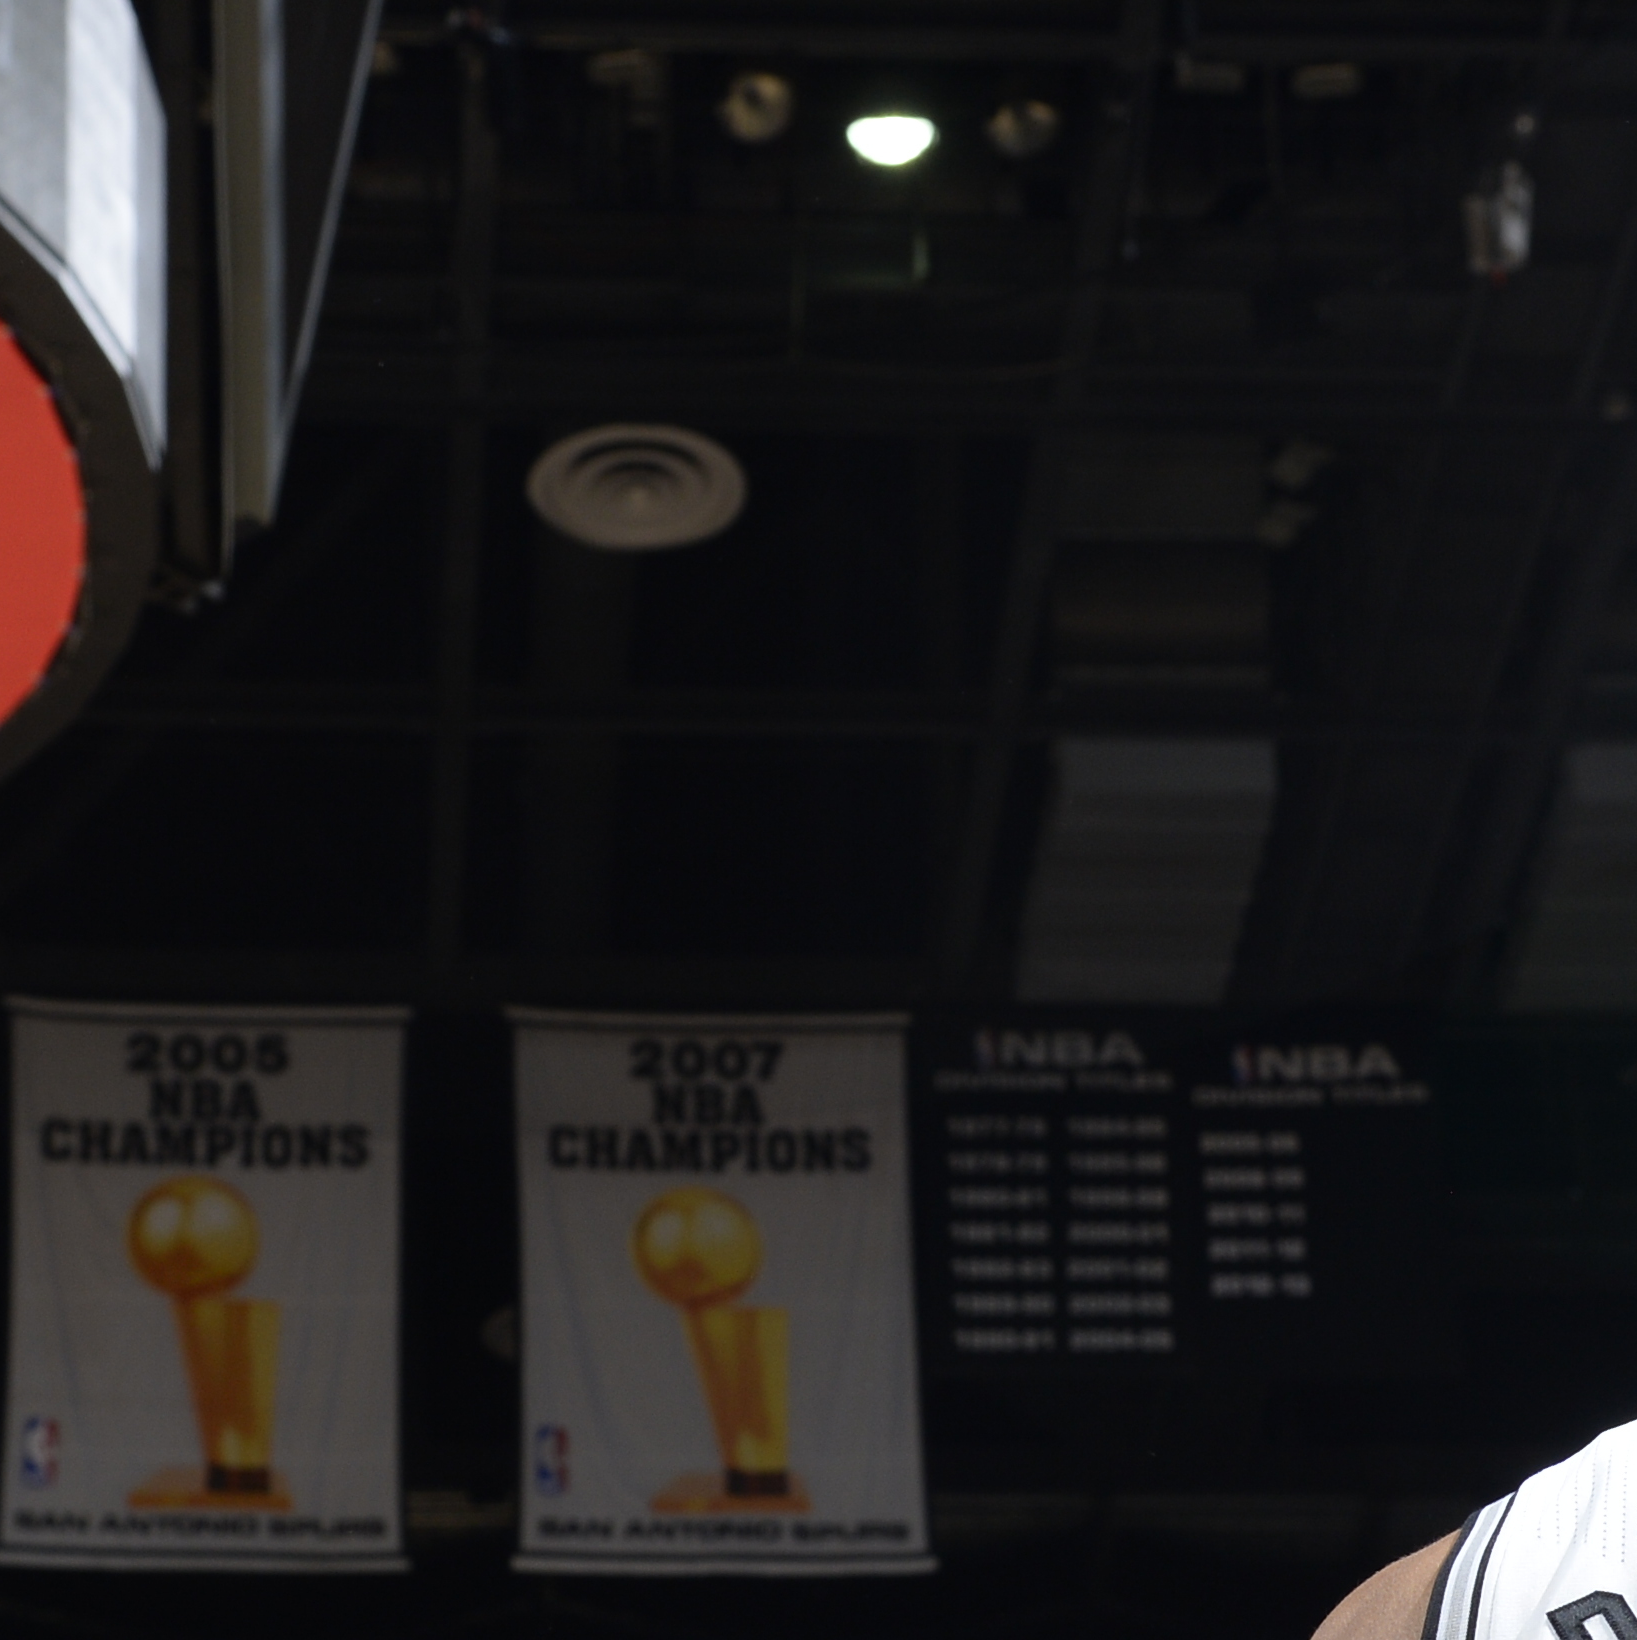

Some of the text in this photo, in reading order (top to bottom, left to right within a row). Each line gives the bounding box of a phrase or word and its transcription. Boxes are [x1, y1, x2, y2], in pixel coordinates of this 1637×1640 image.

[127, 1033, 288, 1073] 2005
[630, 1041, 783, 1080] 2007
[999, 1030, 1147, 1067] NBA
[1257, 1043, 1401, 1082] NBA
[149, 1080, 261, 1120] NBA
[652, 1084, 763, 1126] NBA
[41, 1120, 370, 1168] CHAMPIONS
[548, 1126, 872, 1172] CHAMPIONS
